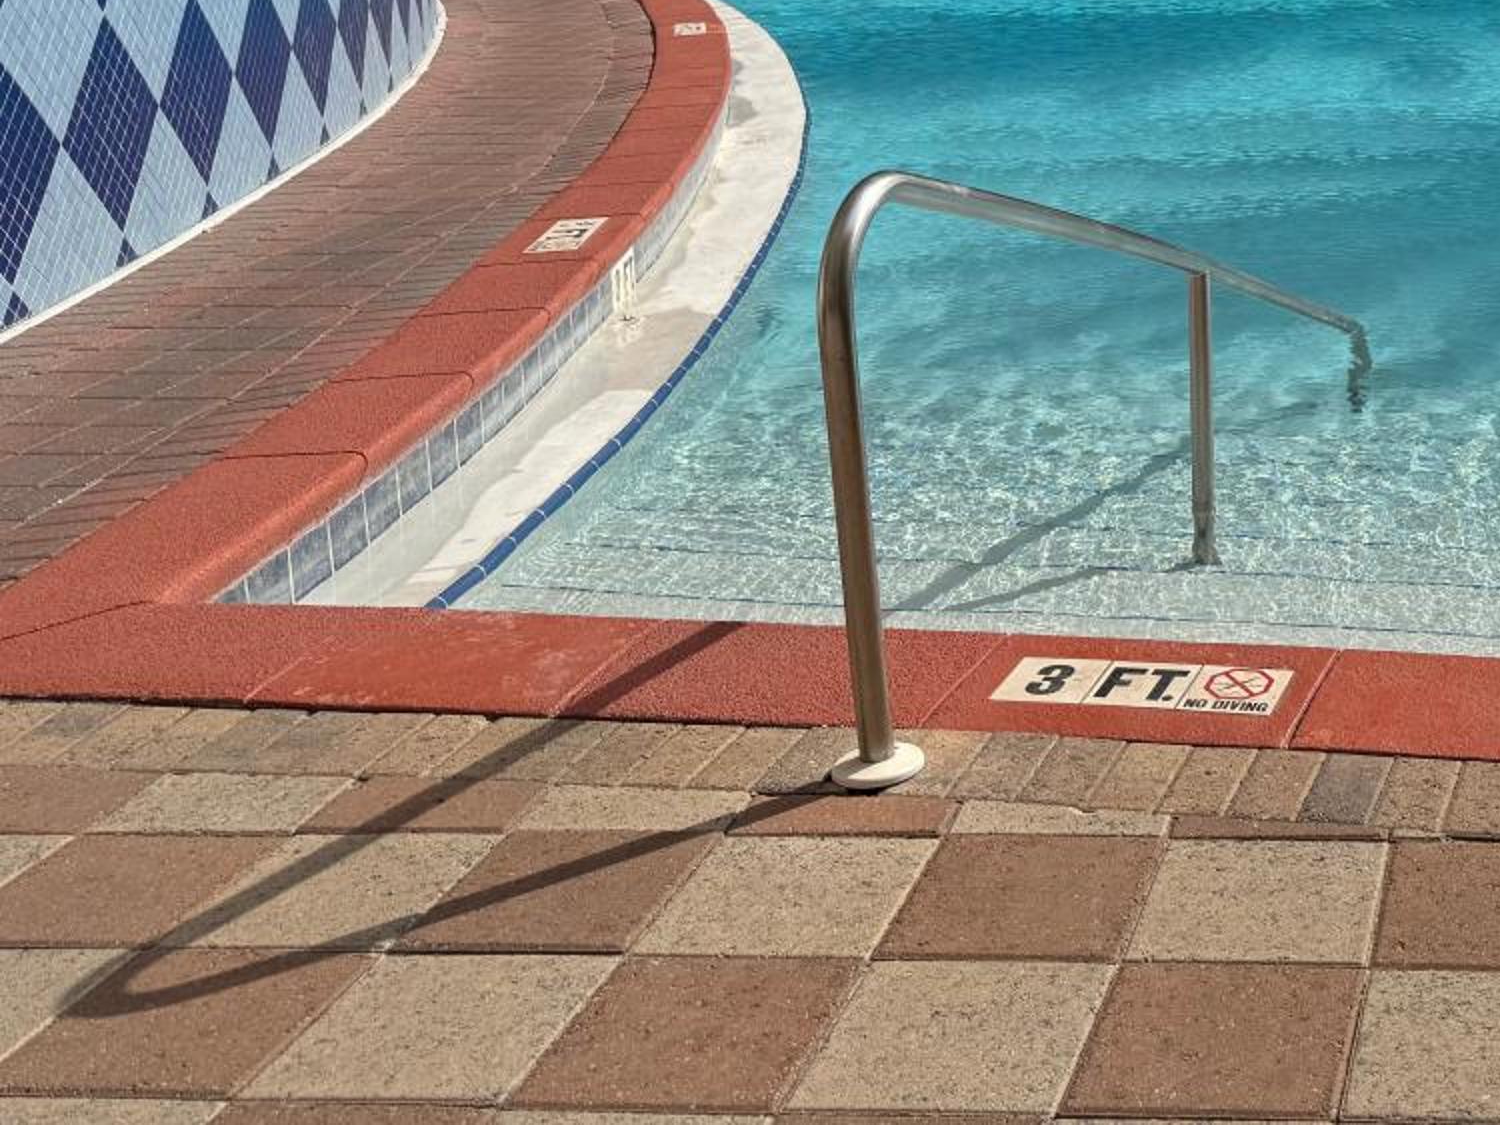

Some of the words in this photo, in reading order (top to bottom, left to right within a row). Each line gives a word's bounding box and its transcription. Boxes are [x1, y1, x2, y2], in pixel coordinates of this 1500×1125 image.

[1025, 664, 1075, 695] 3
[1093, 666, 1191, 702] FT.
[1183, 698, 1208, 708] NO
[1211, 701, 1269, 712] DIVING
